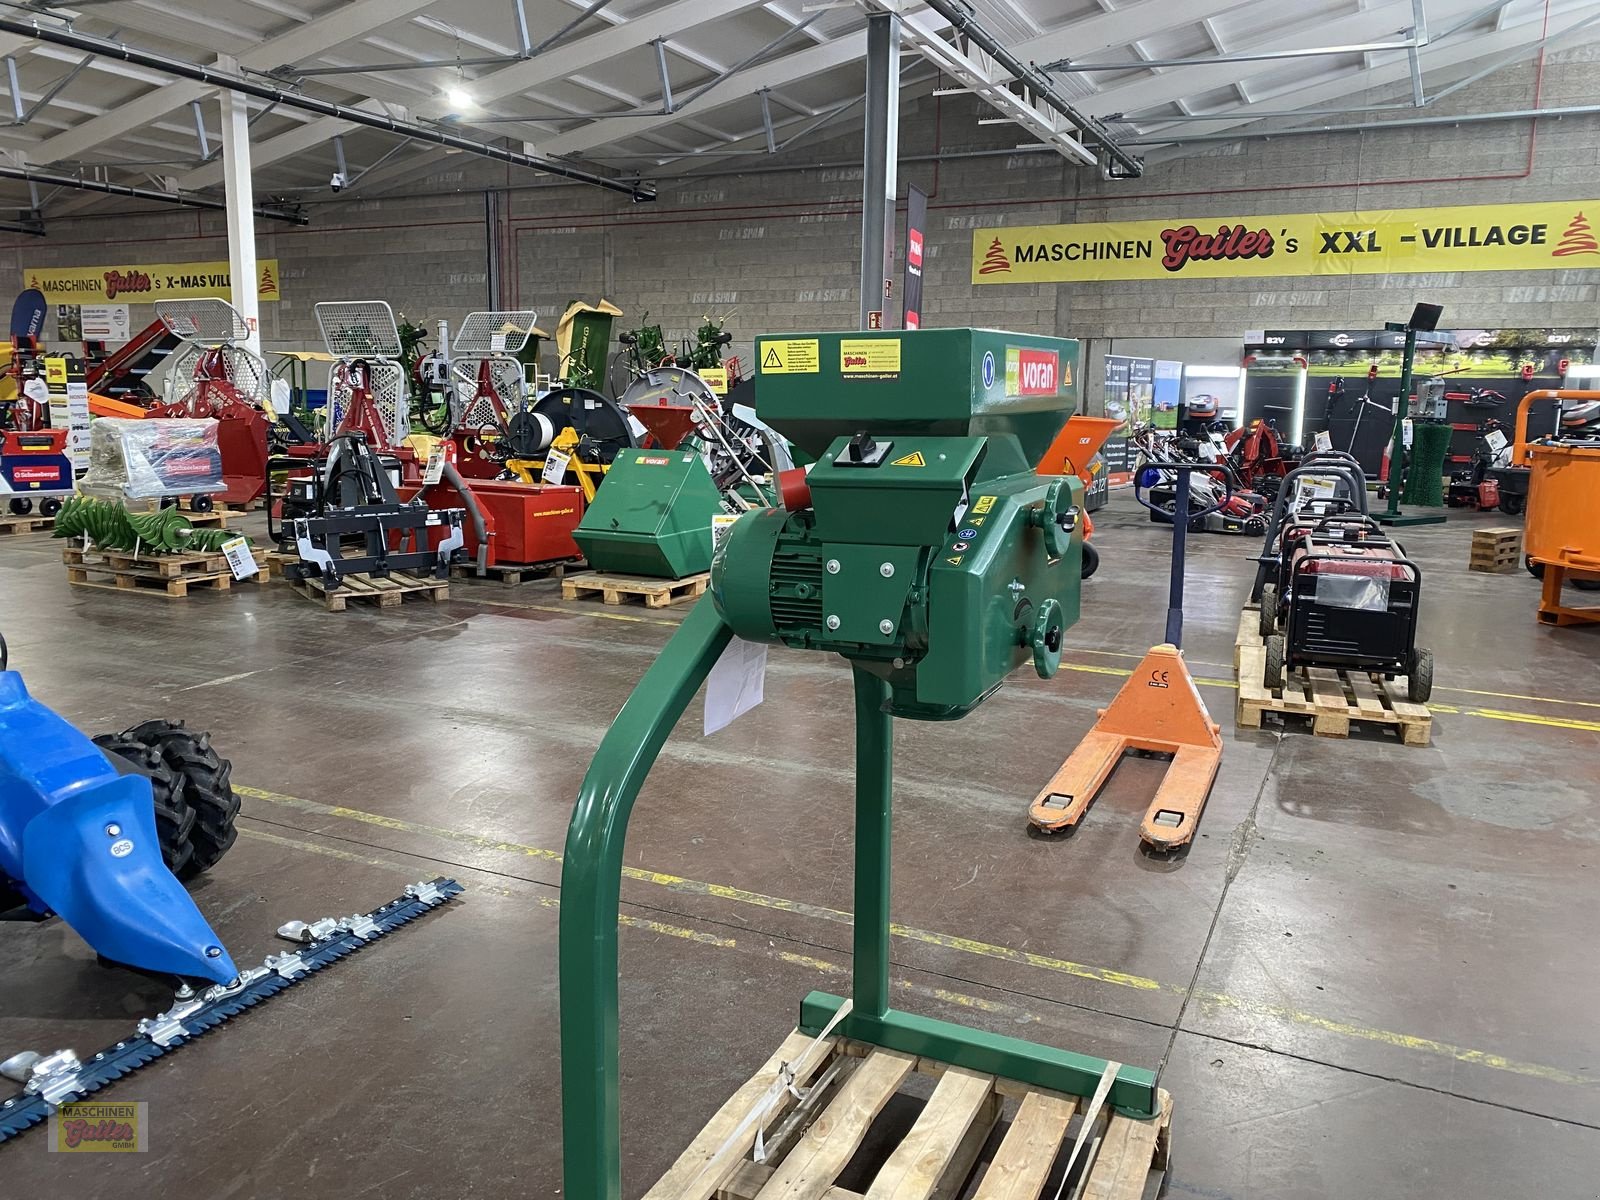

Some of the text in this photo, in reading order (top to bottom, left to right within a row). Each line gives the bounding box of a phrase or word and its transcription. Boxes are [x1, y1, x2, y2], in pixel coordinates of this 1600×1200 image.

[1014, 240, 1152, 263] MASCHINEN
[1160, 224, 1275, 272] Gailer
[1319, 229, 1382, 254] XXL
[43, 279, 101, 292] MASCHINEN
[103, 269, 152, 299] Gailer
[166, 275, 206, 289] X-MAS
[208, 273, 231, 288] VILL
[27, 309, 41, 336] varna
[1023, 362, 1054, 389] voran
[1151, 670, 1168, 682] CE
[113, 842, 131, 854] BCS
